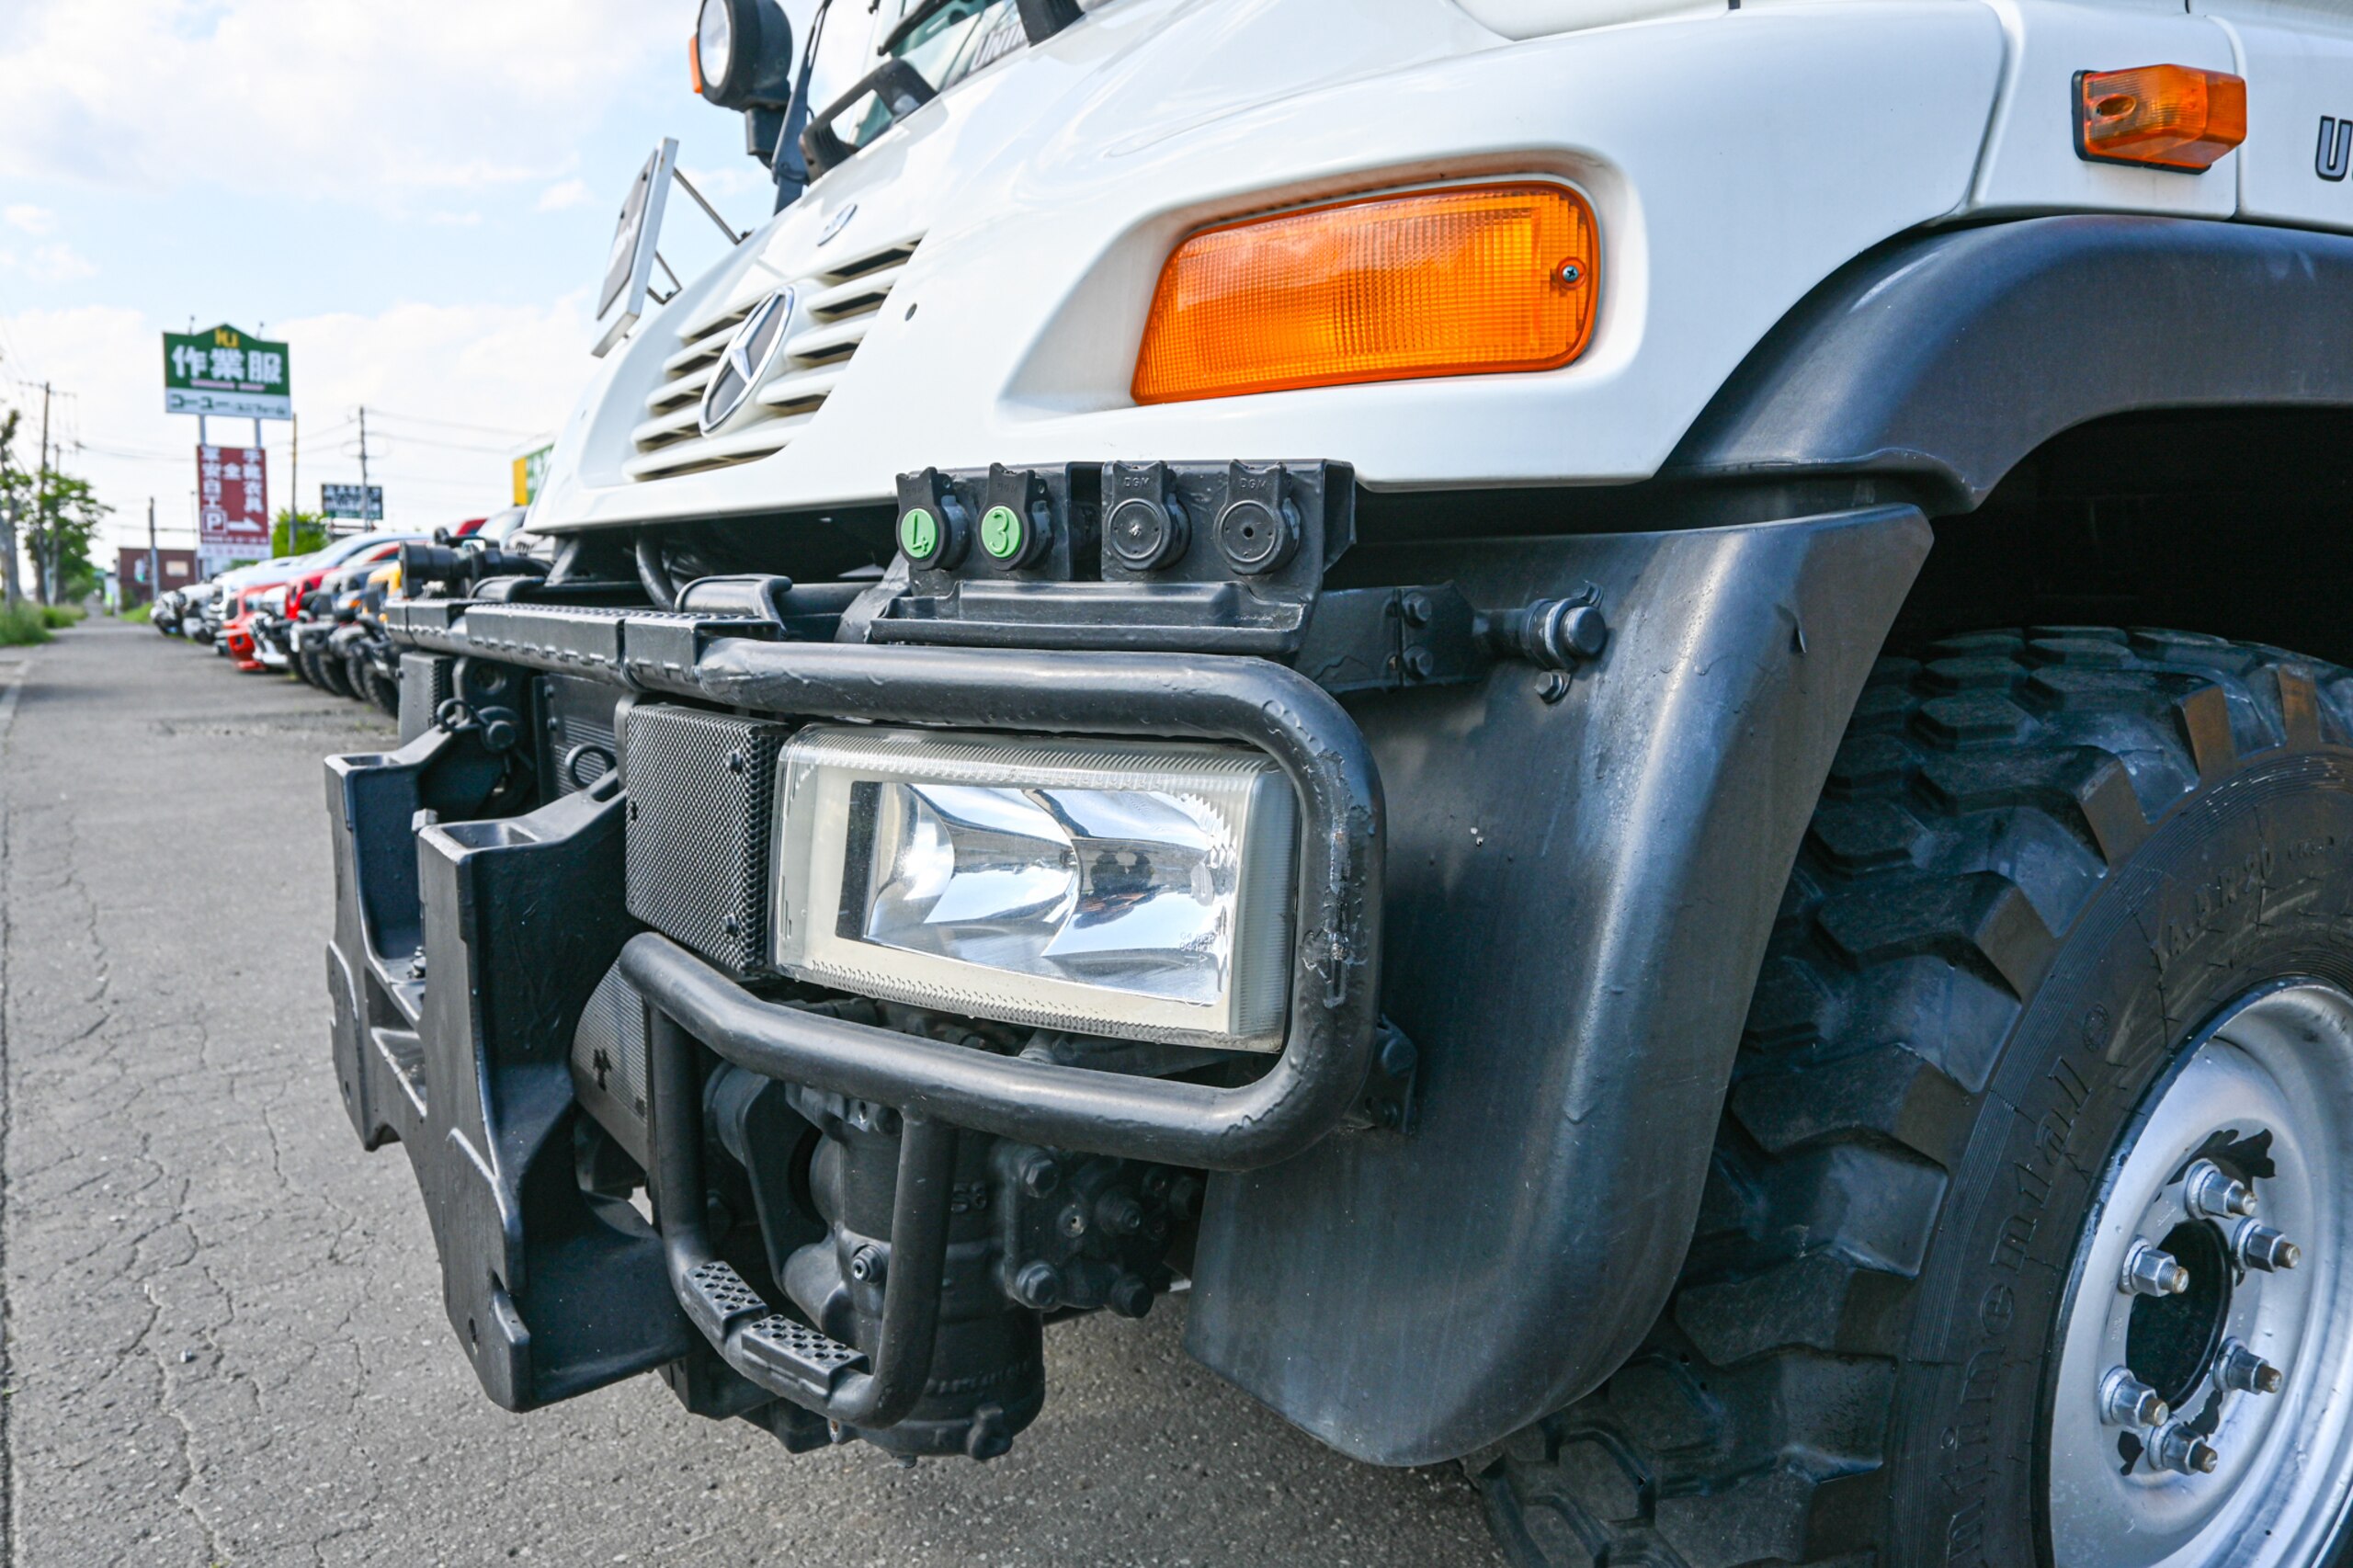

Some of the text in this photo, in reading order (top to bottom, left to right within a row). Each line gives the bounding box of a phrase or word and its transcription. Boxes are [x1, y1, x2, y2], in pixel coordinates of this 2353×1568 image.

[2314, 115, 2353, 182] U
[172, 345, 282, 383] 作業服
[206, 512, 222, 531] P
[912, 513, 929, 555] 4
[989, 509, 1009, 554] 3
[1941, 1054, 2093, 1568] ntinental
